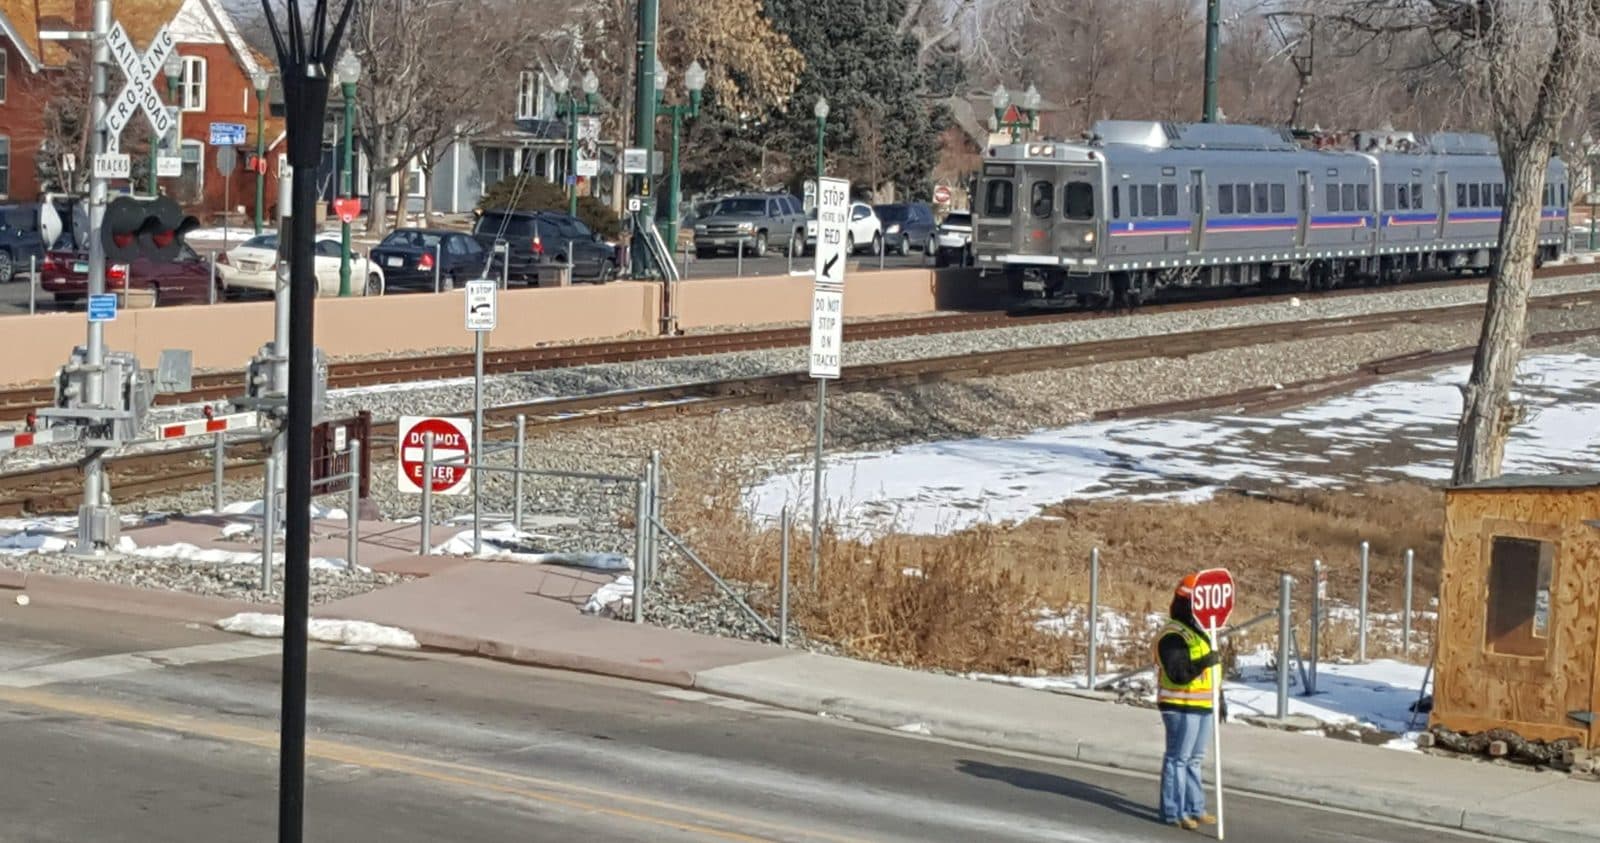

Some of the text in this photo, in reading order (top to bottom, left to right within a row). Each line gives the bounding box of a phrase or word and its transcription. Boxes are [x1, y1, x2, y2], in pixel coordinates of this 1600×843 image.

[110, 31, 172, 131] CROSSING
[96, 159, 128, 172] TRACKS
[823, 189, 845, 206] STOP
[824, 228, 840, 244] RED
[827, 296, 840, 312] NOT
[818, 316, 836, 330] STOP
[821, 335, 832, 348] ON
[812, 353, 838, 367] TRACKS
[435, 433, 460, 446] NOT
[414, 465, 455, 479] ETER
[1194, 584, 1232, 610] STOP
